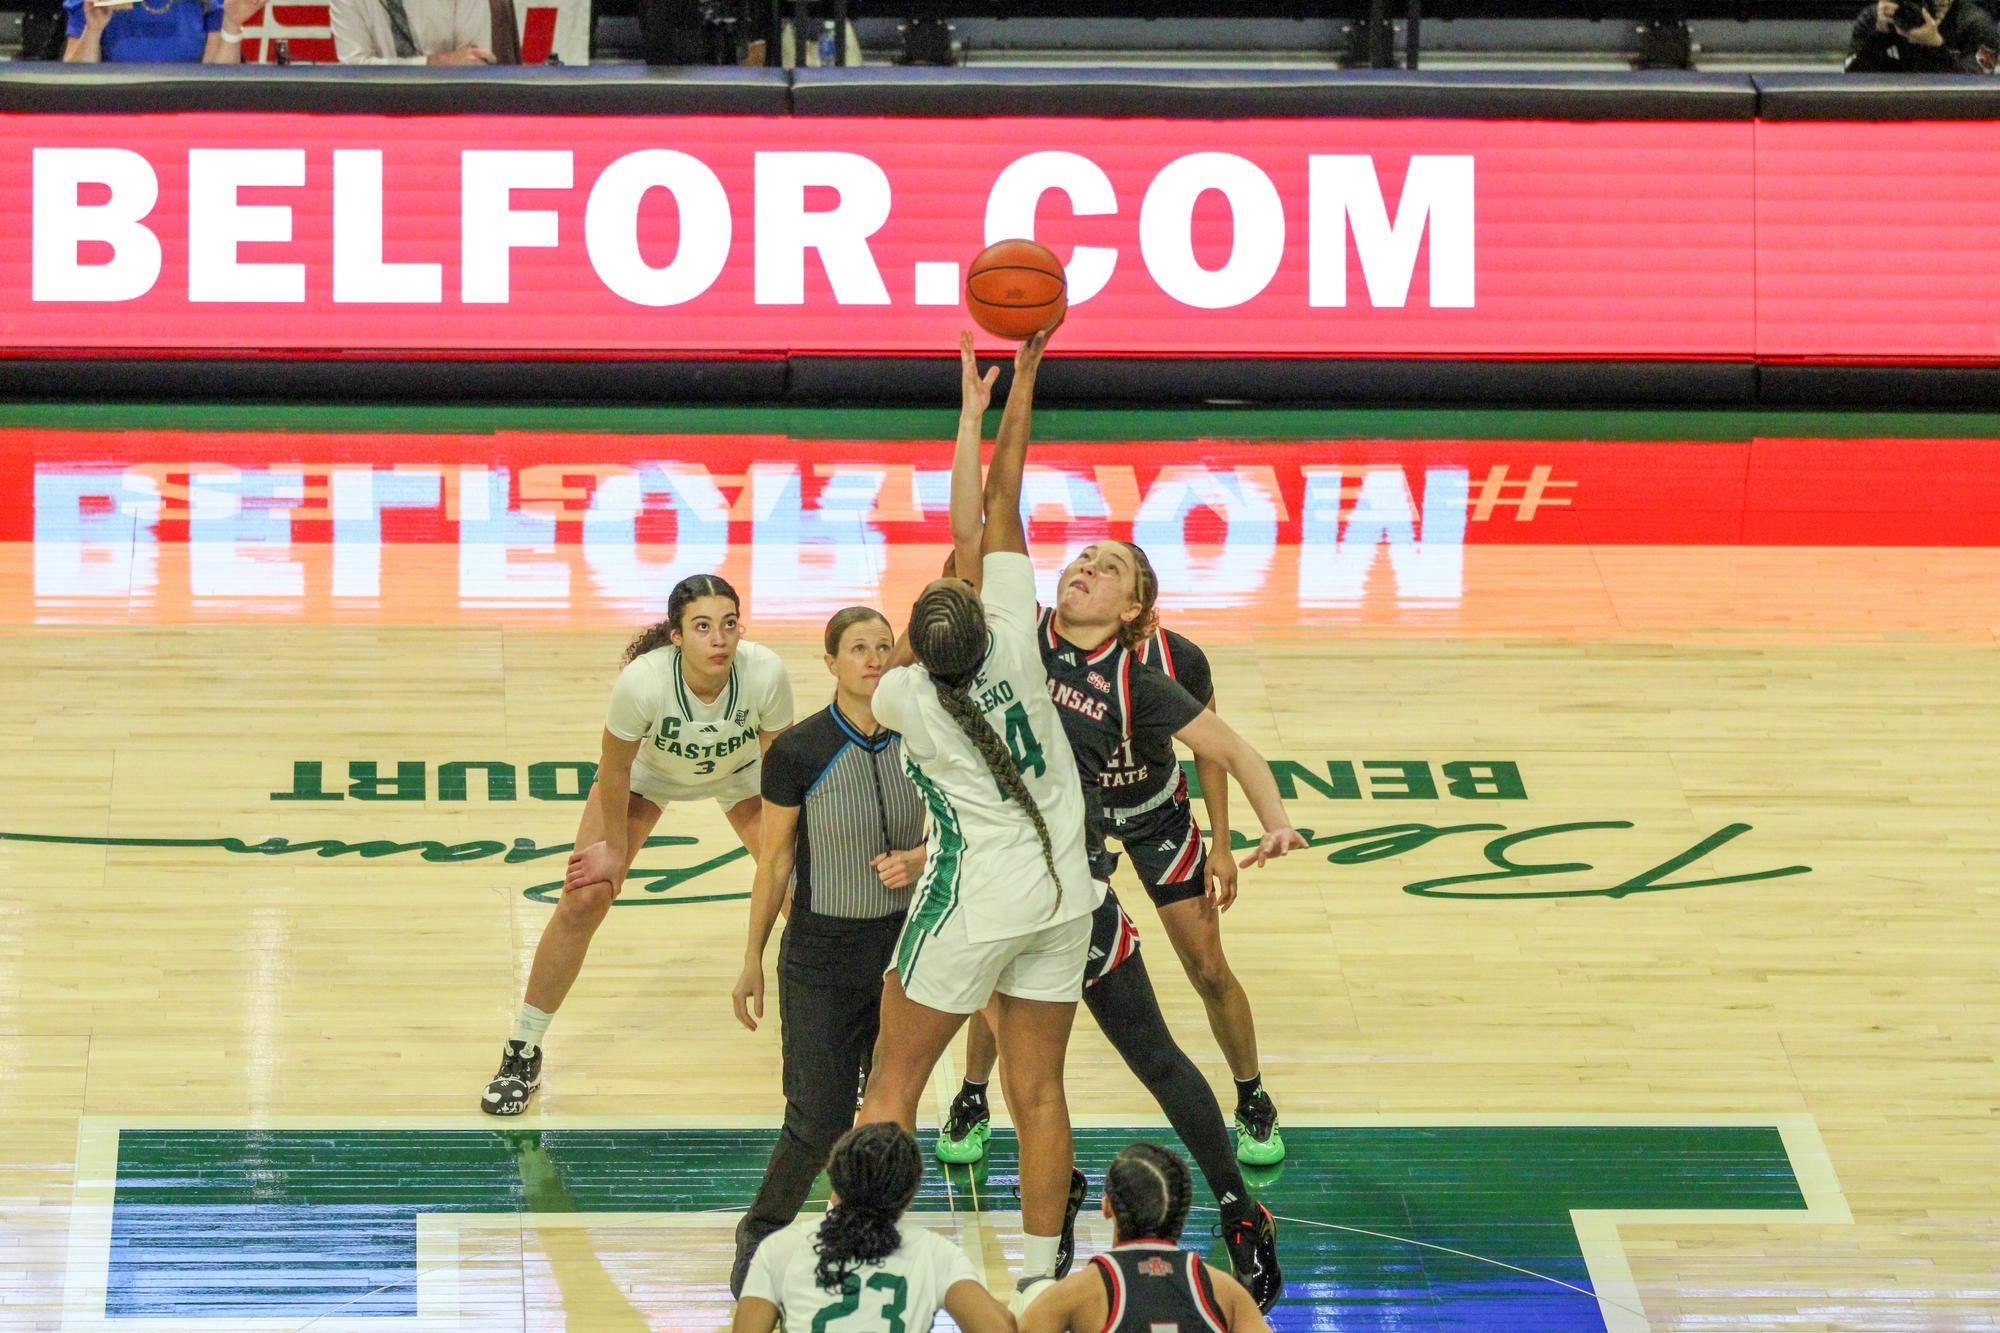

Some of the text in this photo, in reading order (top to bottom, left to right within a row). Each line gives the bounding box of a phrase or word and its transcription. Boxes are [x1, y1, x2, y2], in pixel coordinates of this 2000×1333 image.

[30, 147, 1477, 309] BELFOR.COM
[974, 680, 1014, 714] LEKO
[1047, 679, 1108, 720] ANSAS
[655, 726, 756, 759] EASTERN
[661, 716, 681, 739] C
[693, 760, 716, 774] 3
[1000, 701, 1047, 801] 4
[270, 760, 598, 801] OURT
[1098, 764, 1148, 787] TATE
[811, 1271, 907, 1333] 23
